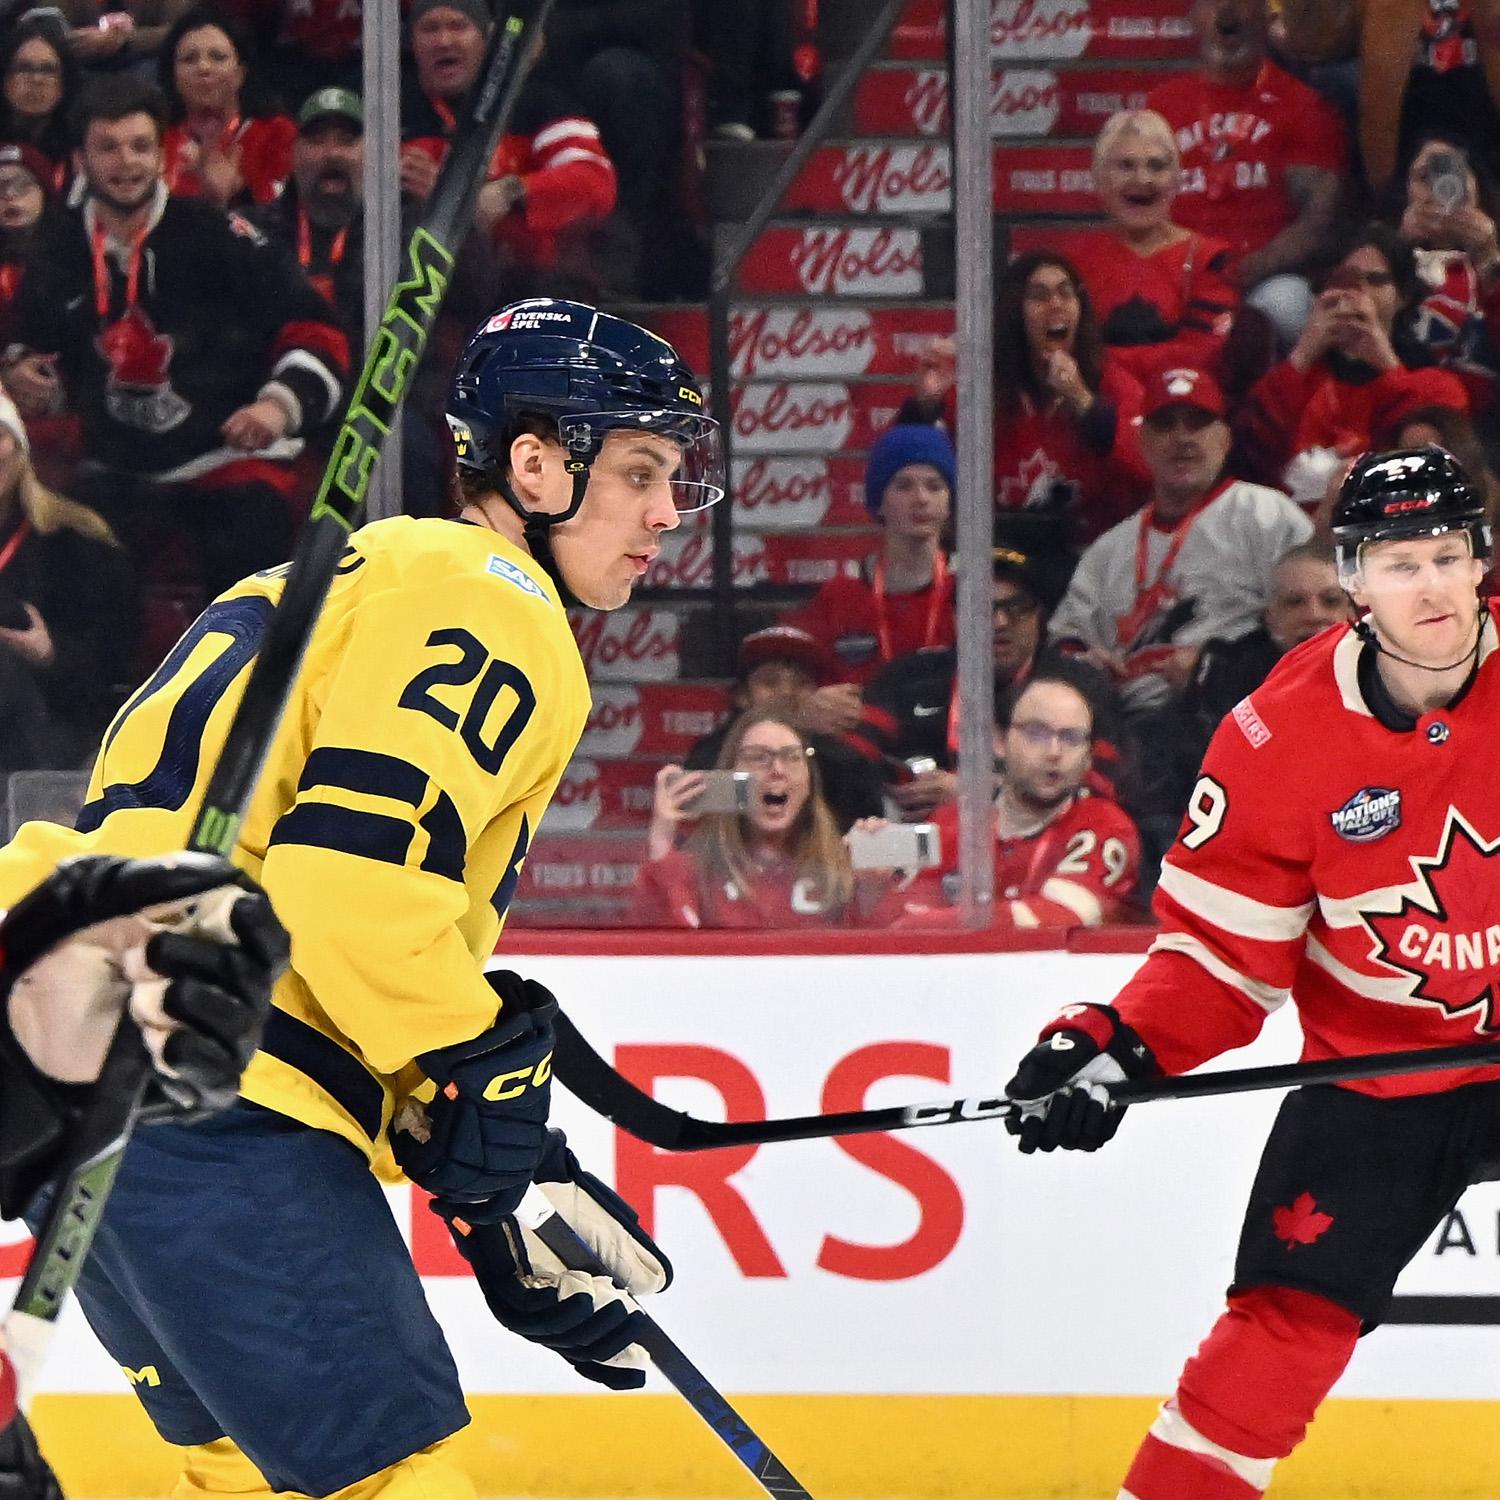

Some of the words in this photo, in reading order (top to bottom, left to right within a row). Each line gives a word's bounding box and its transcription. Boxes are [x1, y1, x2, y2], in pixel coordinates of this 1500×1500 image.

[833, 145, 950, 215] Mols
[790, 228, 923, 297] Mols
[510, 320, 542, 330] SPEL
[513, 312, 572, 323] SVENSKA
[731, 382, 850, 438] olson
[398, 627, 538, 777] 20
[1181, 774, 1229, 852] 9
[1331, 789, 1400, 826] NATIONS
[1056, 828, 1130, 888] 29
[482, 1050, 554, 1102] CC
